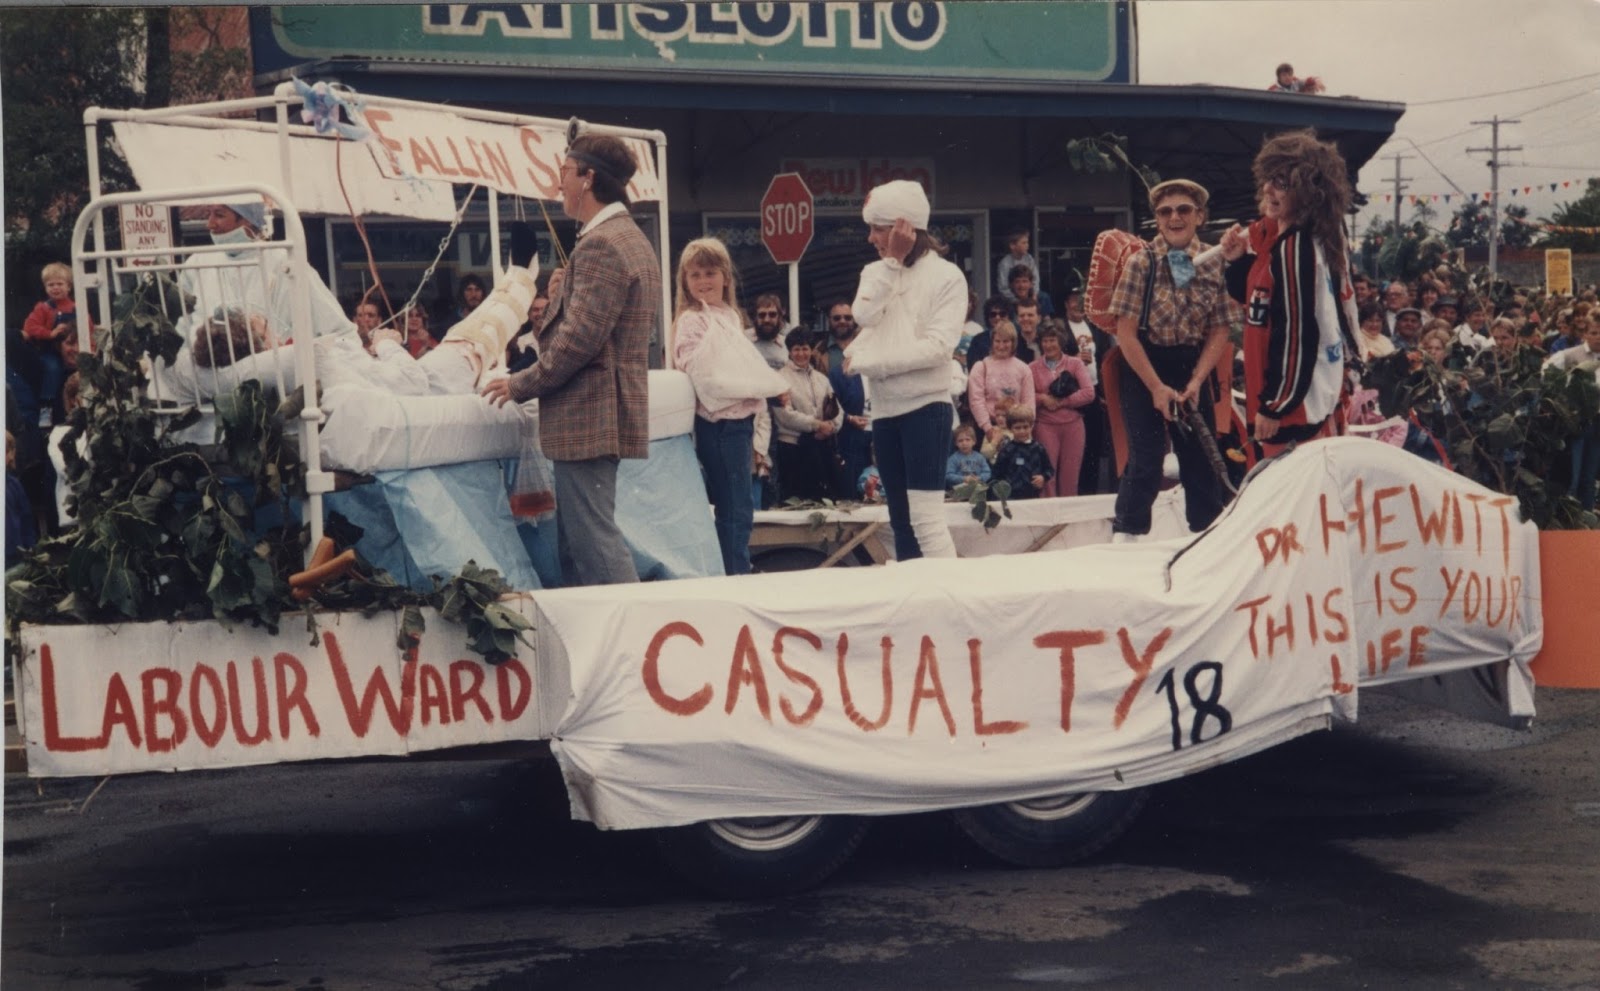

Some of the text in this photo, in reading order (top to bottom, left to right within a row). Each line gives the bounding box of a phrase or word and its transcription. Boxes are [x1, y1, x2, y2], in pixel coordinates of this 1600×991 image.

[363, 109, 517, 189] FALLEN
[126, 220, 166, 234] STANDING
[135, 204, 154, 218] NO
[139, 236, 155, 245] ANY
[765, 201, 810, 236] STOP
[1256, 478, 1513, 573] DR HEWITT
[1235, 566, 1522, 659] THIS IS YOUR
[40, 631, 532, 752] LABOUR WARD
[642, 621, 1172, 737] CASUALTY
[1155, 661, 1232, 750] 18
